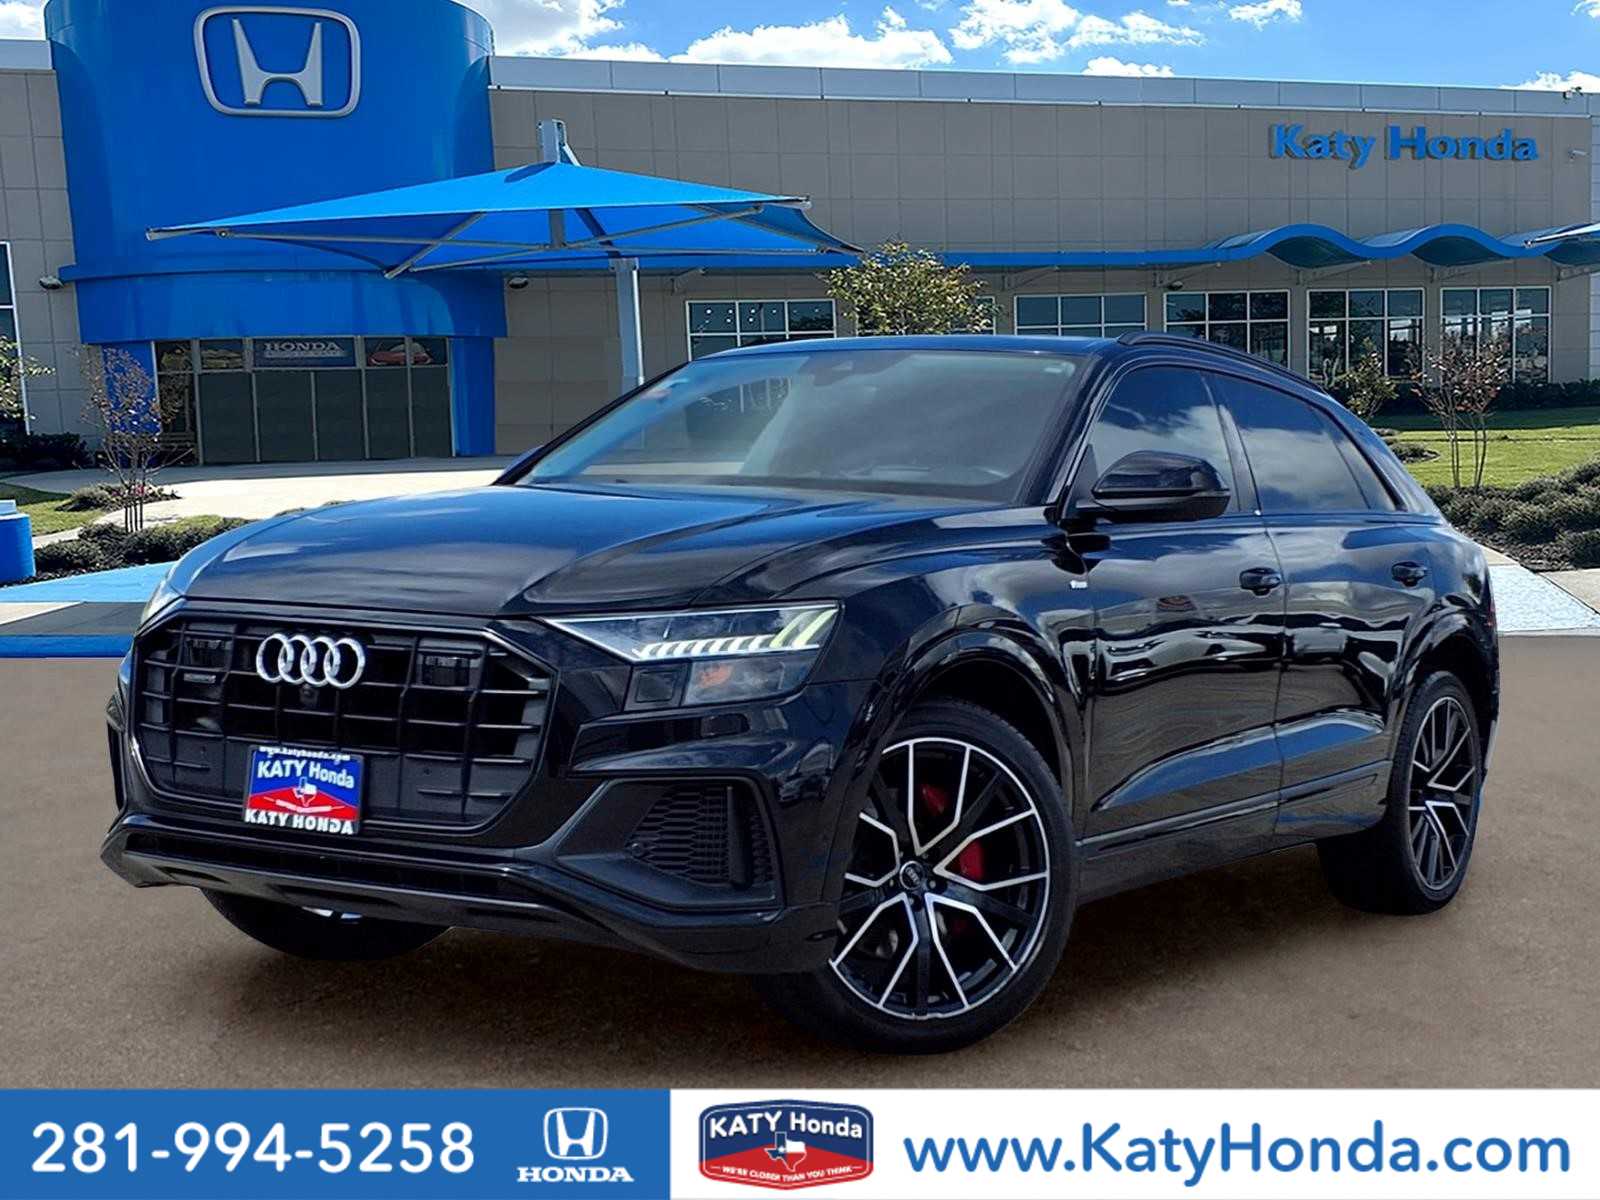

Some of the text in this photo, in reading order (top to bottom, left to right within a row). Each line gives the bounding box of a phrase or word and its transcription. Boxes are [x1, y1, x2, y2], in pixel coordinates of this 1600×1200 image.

[1270, 123, 1539, 168] Katy Honda
[264, 341, 344, 352] HONDA
[257, 760, 355, 789] KATY Honda
[245, 808, 354, 835] KATY HONDA
